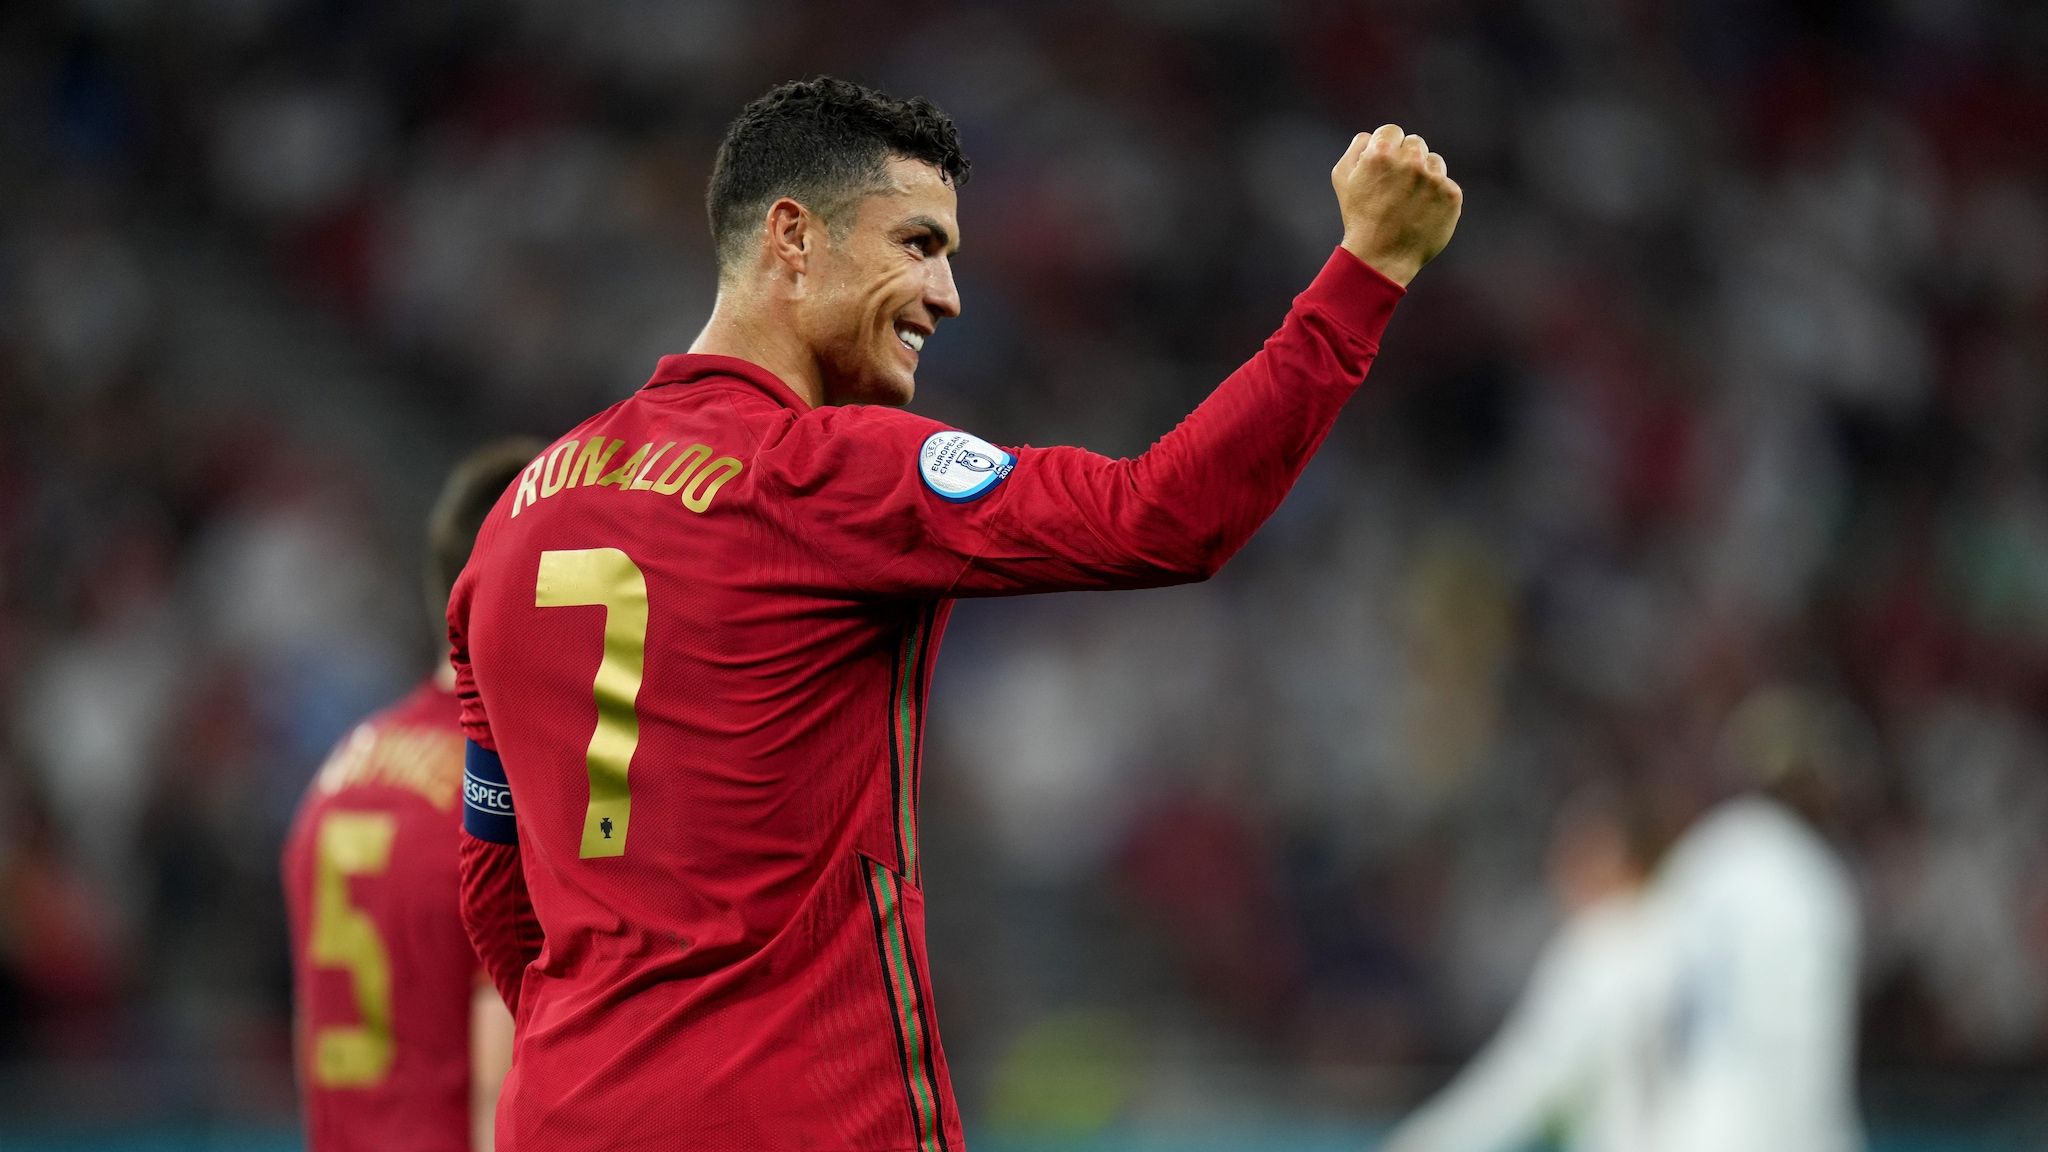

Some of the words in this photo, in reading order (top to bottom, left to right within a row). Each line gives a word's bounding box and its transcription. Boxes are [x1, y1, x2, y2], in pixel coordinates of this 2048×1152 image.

[928, 438, 944, 457] UEFA
[932, 435, 961, 471] EUROPEAN
[940, 438, 969, 474] CHAMPIONS
[511, 436, 743, 518] RONALDO
[998, 465, 1014, 479] 2016
[535, 548, 649, 858] 7
[463, 774, 511, 810] ESPEC
[313, 811, 396, 1086] 5
